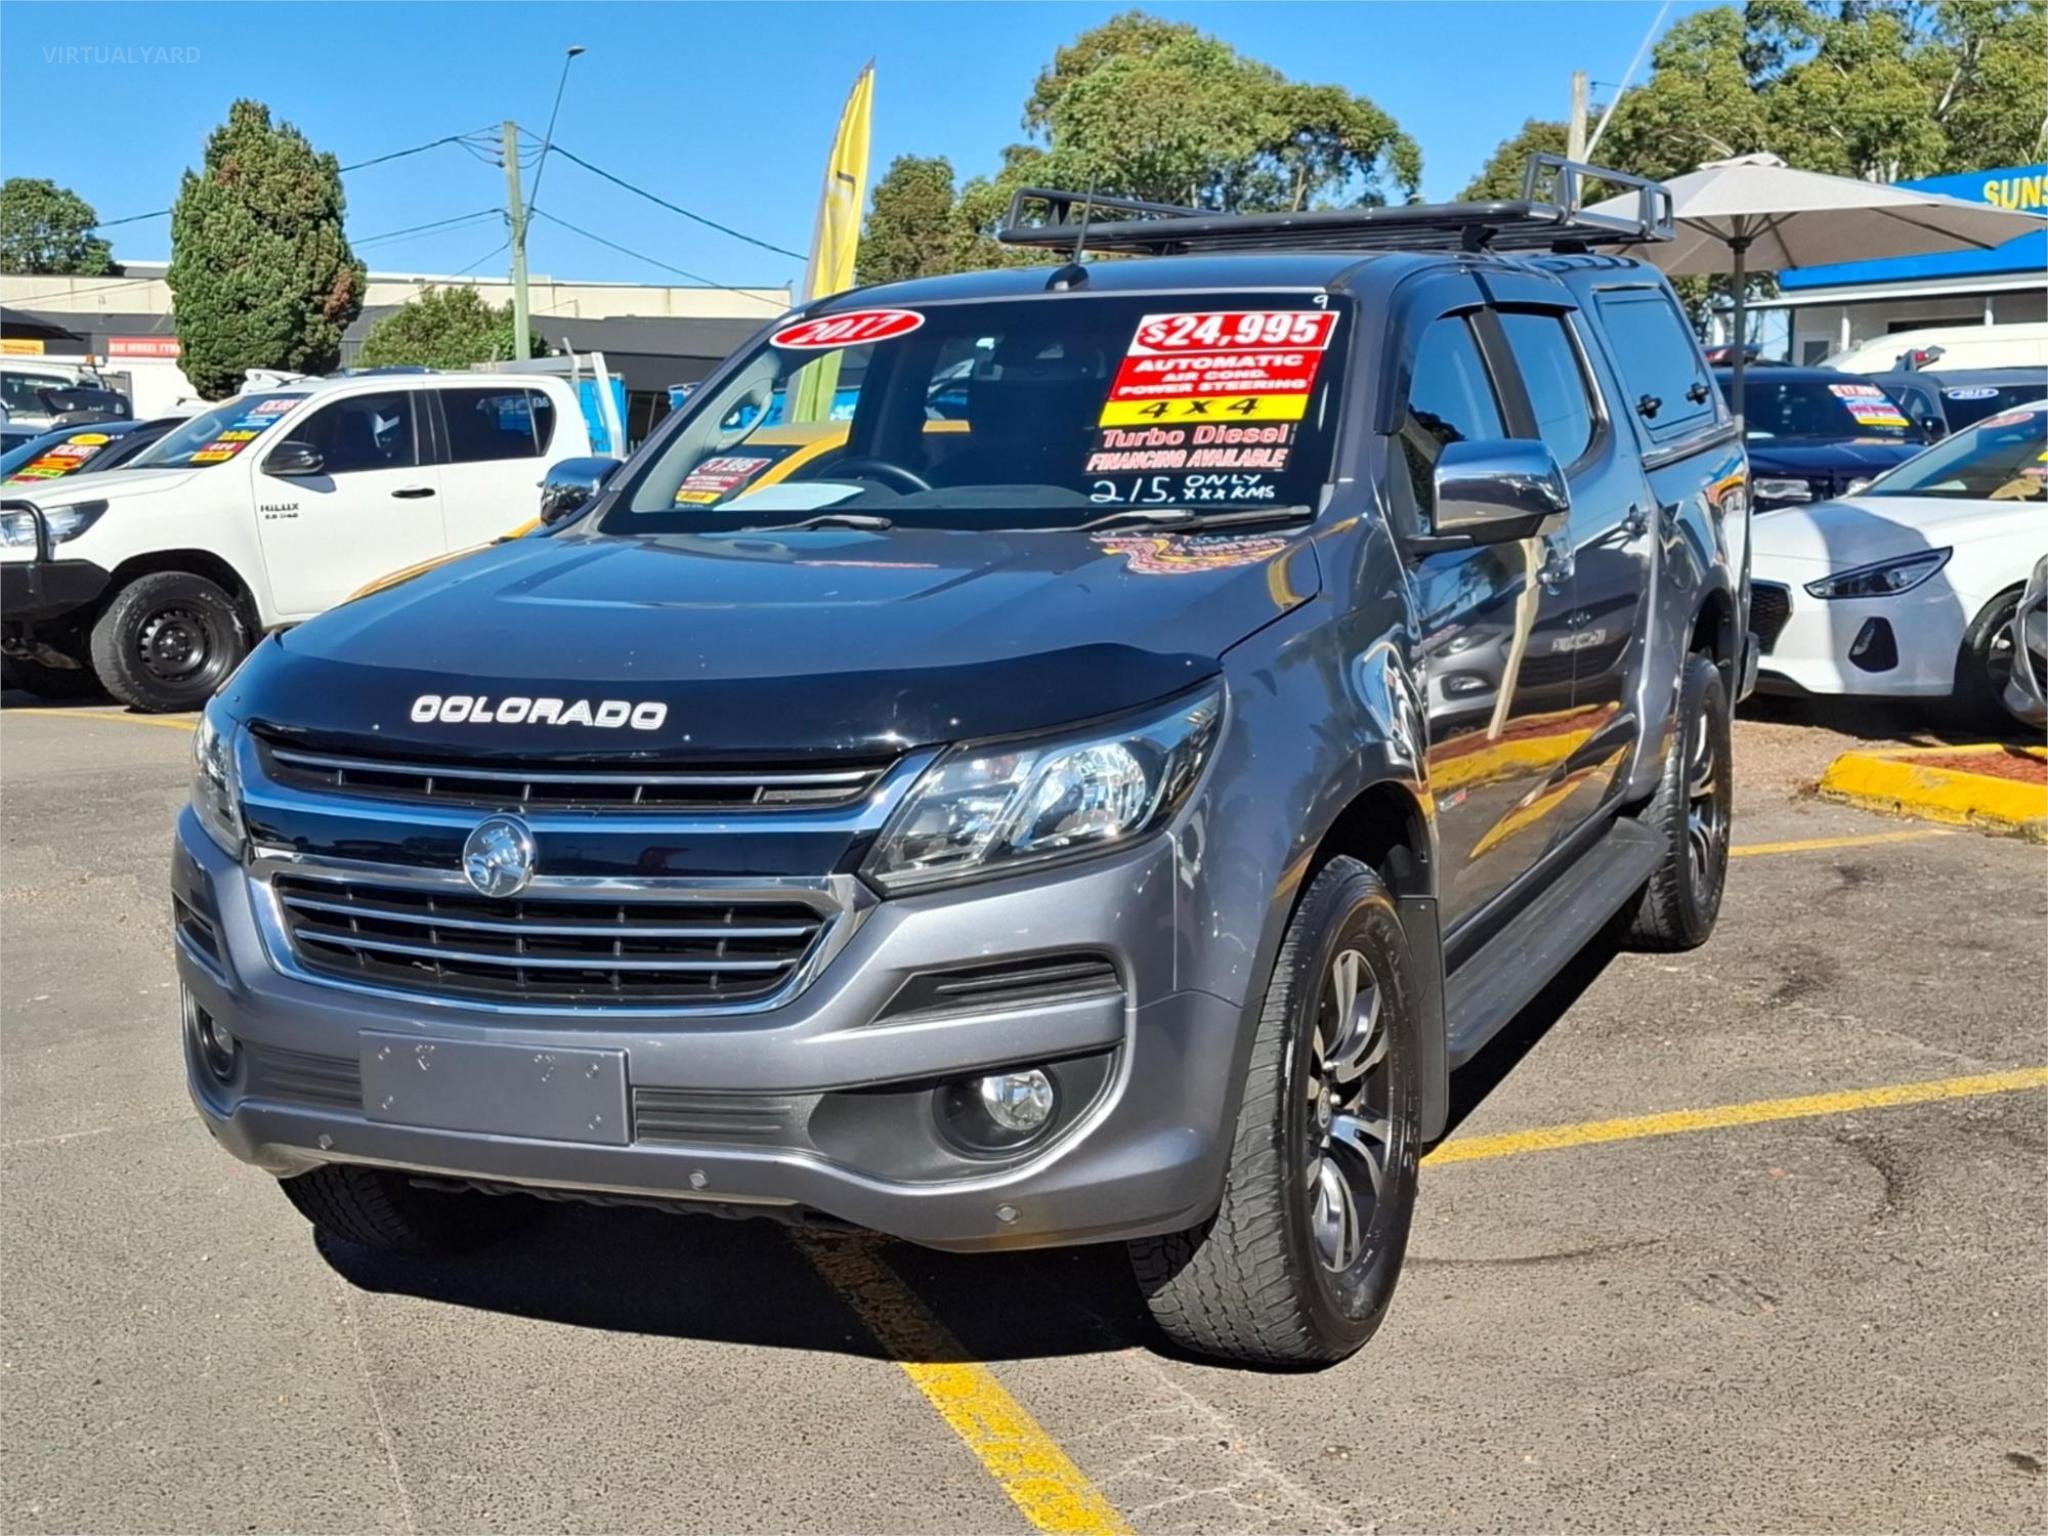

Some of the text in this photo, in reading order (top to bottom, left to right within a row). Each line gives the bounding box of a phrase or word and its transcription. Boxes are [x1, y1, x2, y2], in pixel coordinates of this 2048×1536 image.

[1312, 294, 1328, 309] 9
[787, 313, 907, 344] 2017
[1143, 314, 1322, 346] $24,995
[1133, 354, 1305, 373] AUTOMATIC
[1162, 372, 1201, 382] AIR
[1118, 379, 1308, 396] POWER STEERING
[1102, 423, 1290, 448] Turbo Diesel
[1086, 447, 1290, 472] FINANCING AVAILABLE
[1184, 473, 1262, 486] ONLY
[1229, 485, 1276, 499] KMS
